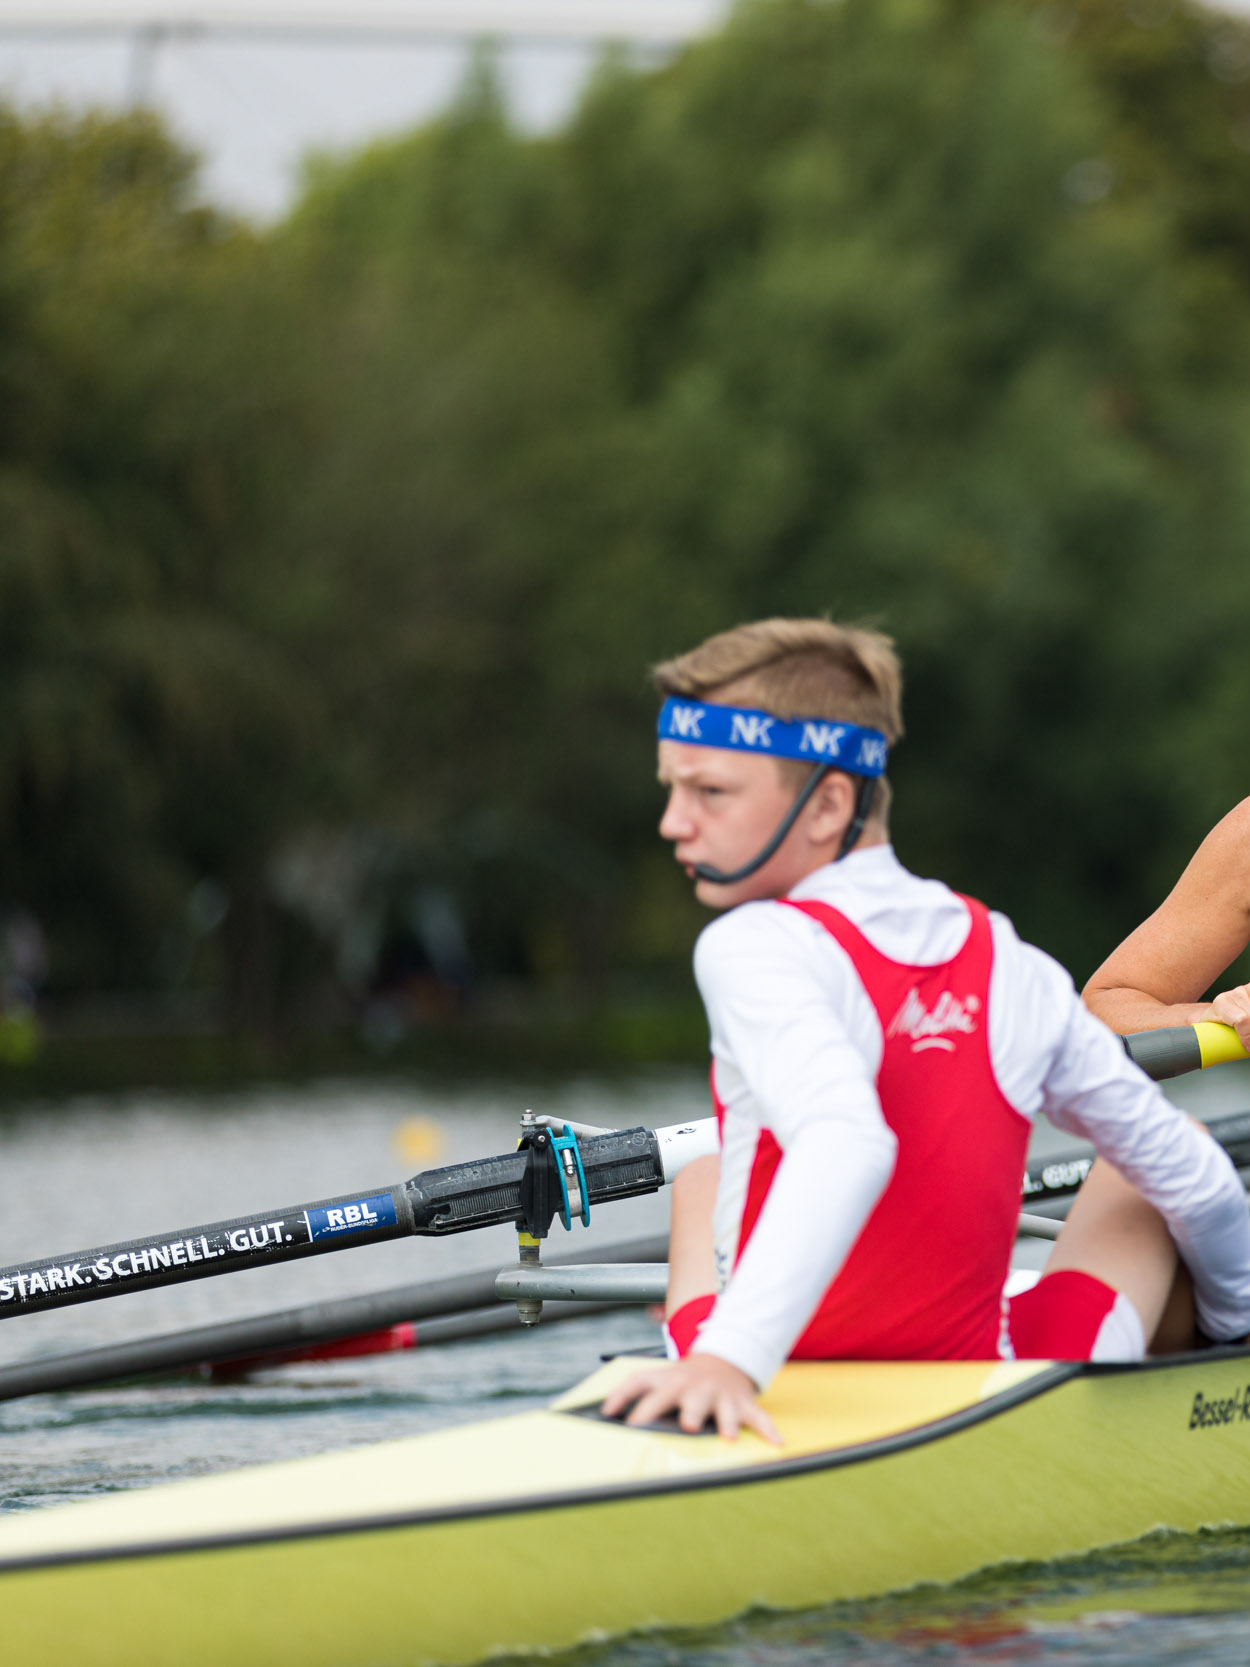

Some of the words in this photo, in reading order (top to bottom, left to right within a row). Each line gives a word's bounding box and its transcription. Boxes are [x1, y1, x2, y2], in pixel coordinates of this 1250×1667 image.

[669, 705, 706, 738] NK
[730, 713, 775, 747] NK
[799, 722, 846, 757] NK
[327, 1203, 378, 1227] RBL
[0, 1261, 92, 1300] STARK.
[95, 1236, 226, 1281] SCHNELL.
[229, 1220, 293, 1252] GUT.
